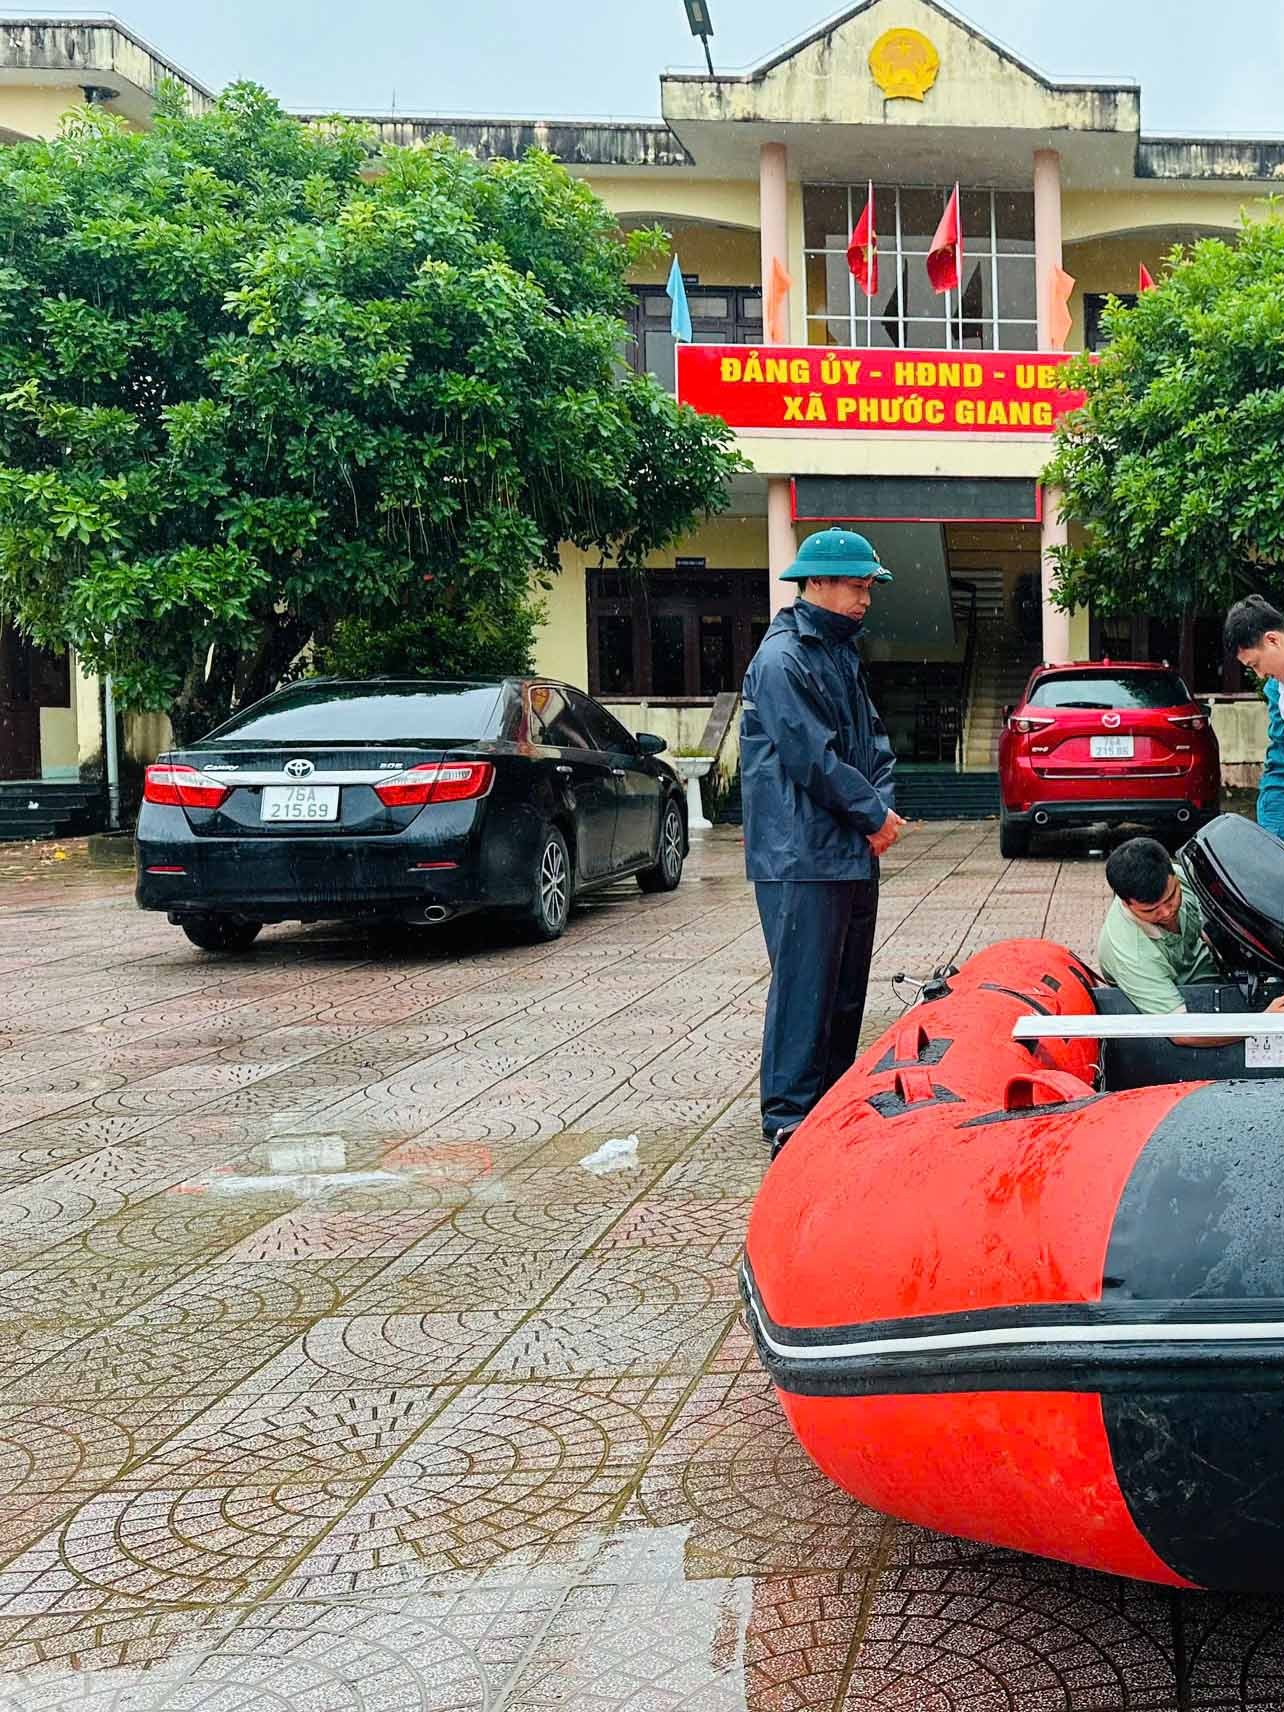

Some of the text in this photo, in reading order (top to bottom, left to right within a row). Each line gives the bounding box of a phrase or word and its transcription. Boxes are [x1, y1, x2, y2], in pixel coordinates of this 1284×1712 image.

[720, 351, 810, 384] ĐẢNG
[820, 352, 862, 385] ỦY
[895, 362, 983, 388] HĐND
[1016, 364, 1066, 389] UB
[784, 392, 1053, 426] XÃ PHƯỚC GIANG
[287, 786, 316, 802] 76A
[271, 803, 329, 818] 215.69
